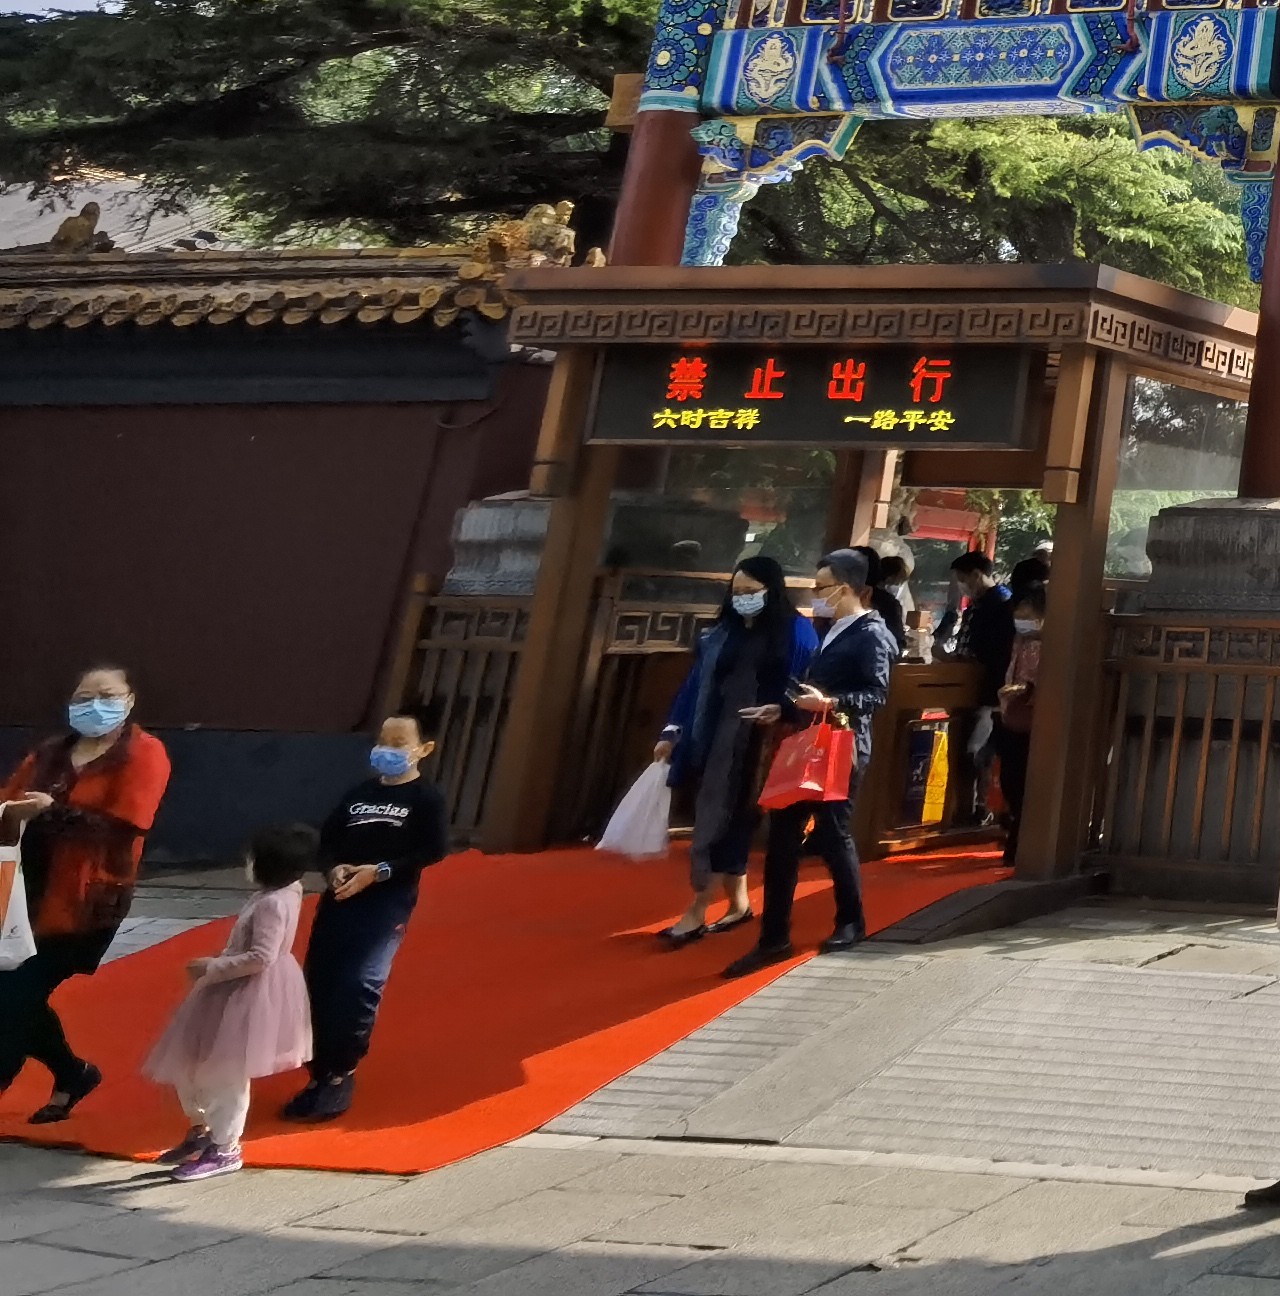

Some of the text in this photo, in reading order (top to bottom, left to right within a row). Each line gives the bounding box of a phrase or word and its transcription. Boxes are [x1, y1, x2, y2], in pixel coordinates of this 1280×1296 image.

[665, 355, 953, 403] 禁止出行
[651, 407, 955, 433] 六时吉祥 一路平安
[349, 802, 409, 818] Gracias
